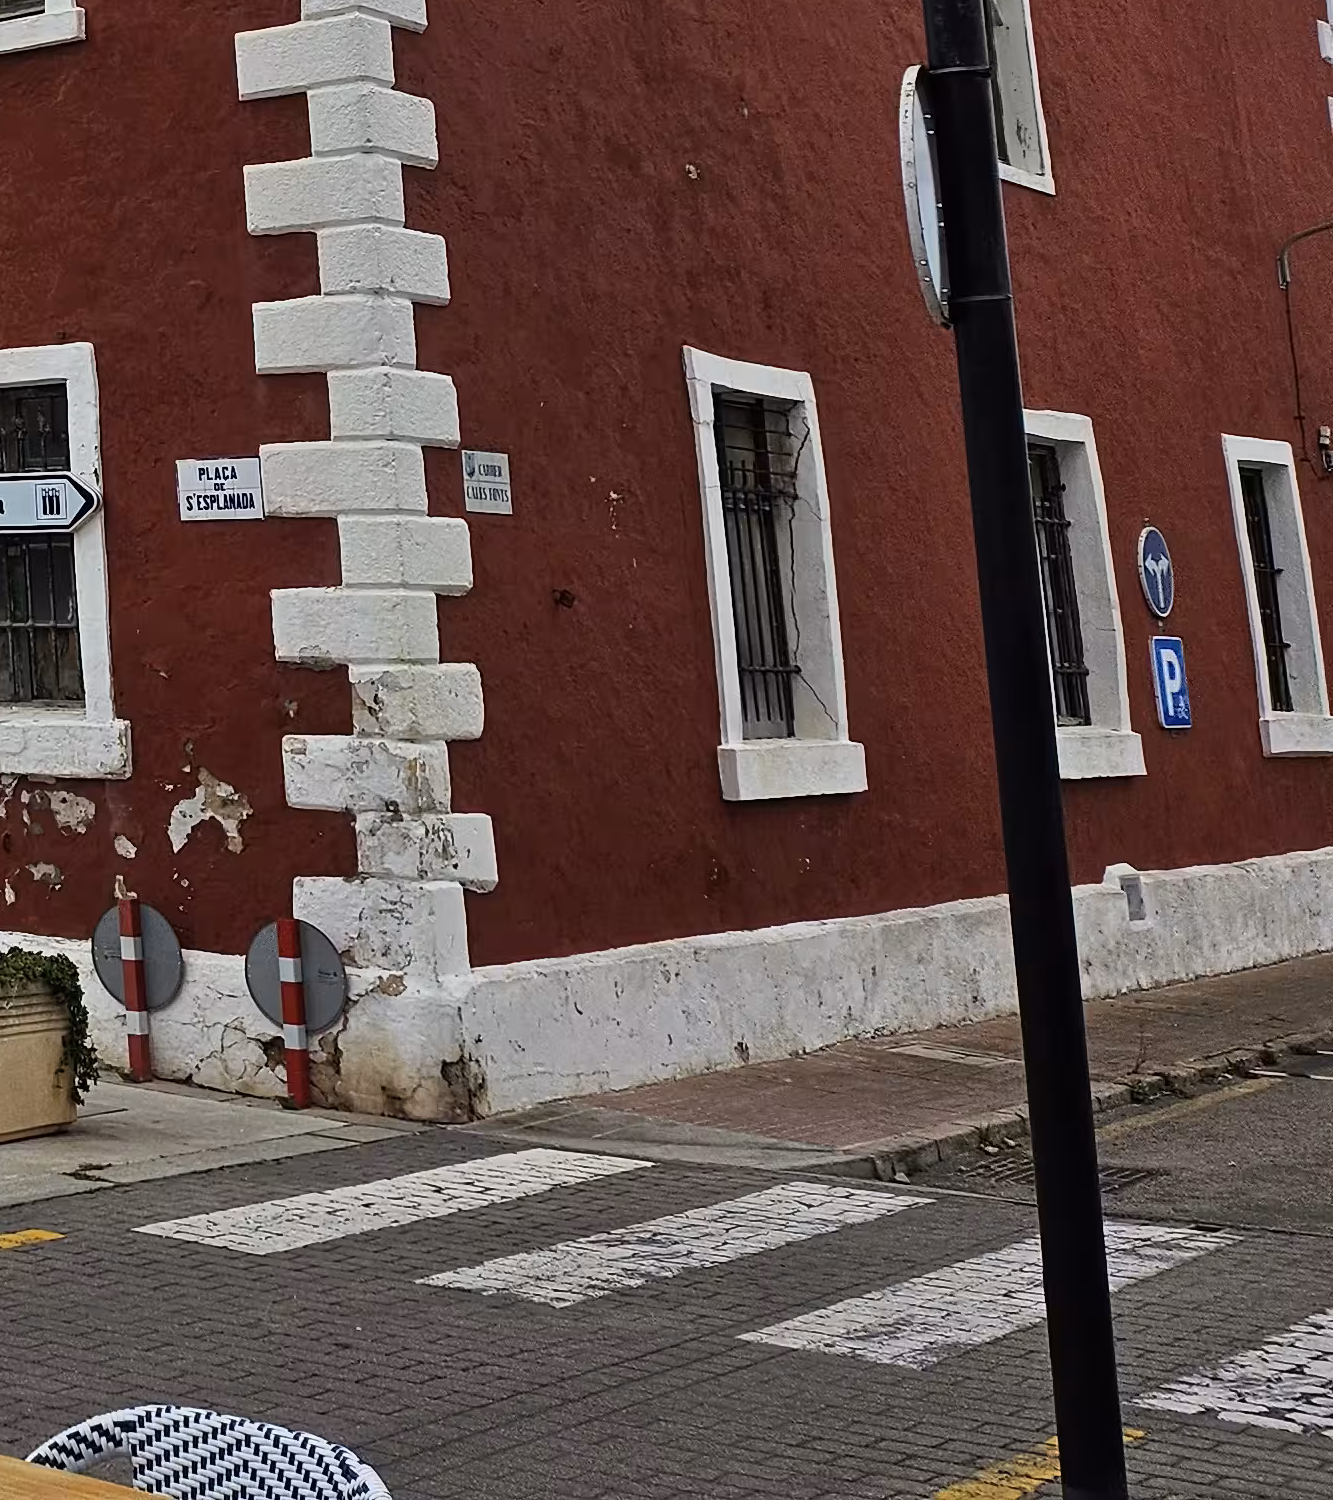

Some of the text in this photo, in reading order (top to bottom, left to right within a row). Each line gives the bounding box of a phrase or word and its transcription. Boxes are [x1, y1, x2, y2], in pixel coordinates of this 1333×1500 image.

[198, 466, 237, 481] PLAÇA
[213, 483, 226, 491] DE
[186, 493, 255, 511] S'ESPLANADA
[1160, 649, 1181, 716] P
